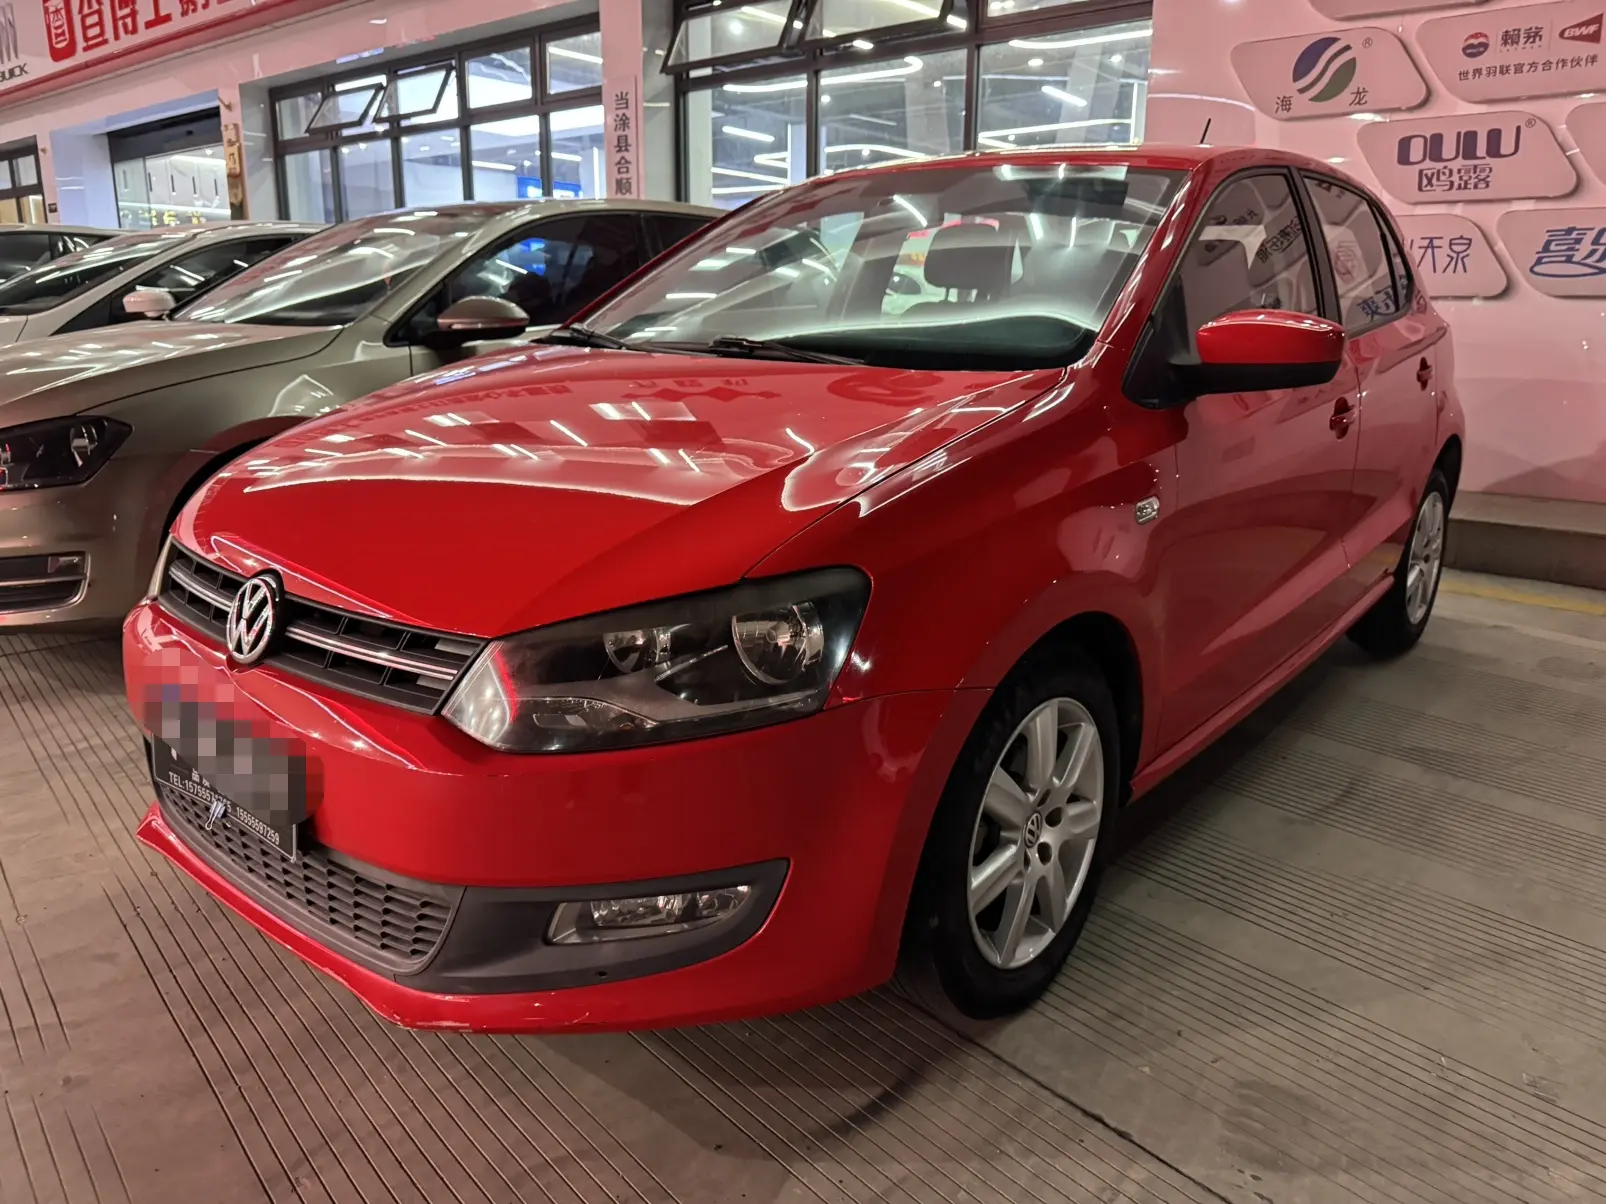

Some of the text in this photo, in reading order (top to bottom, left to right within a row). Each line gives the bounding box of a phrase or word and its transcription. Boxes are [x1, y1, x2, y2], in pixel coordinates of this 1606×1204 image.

[1563, 23, 1600, 38] BWF
[1458, 54, 1599, 82] 世界羽联官方合作伙伴
[1274, 86, 1368, 114] 海 龙
[614, 91, 632, 195] 当涂县合顺
[1396, 125, 1522, 166] OULU
[1417, 163, 1493, 193] 鸥露
[1408, 235, 1473, 275] 天泉
